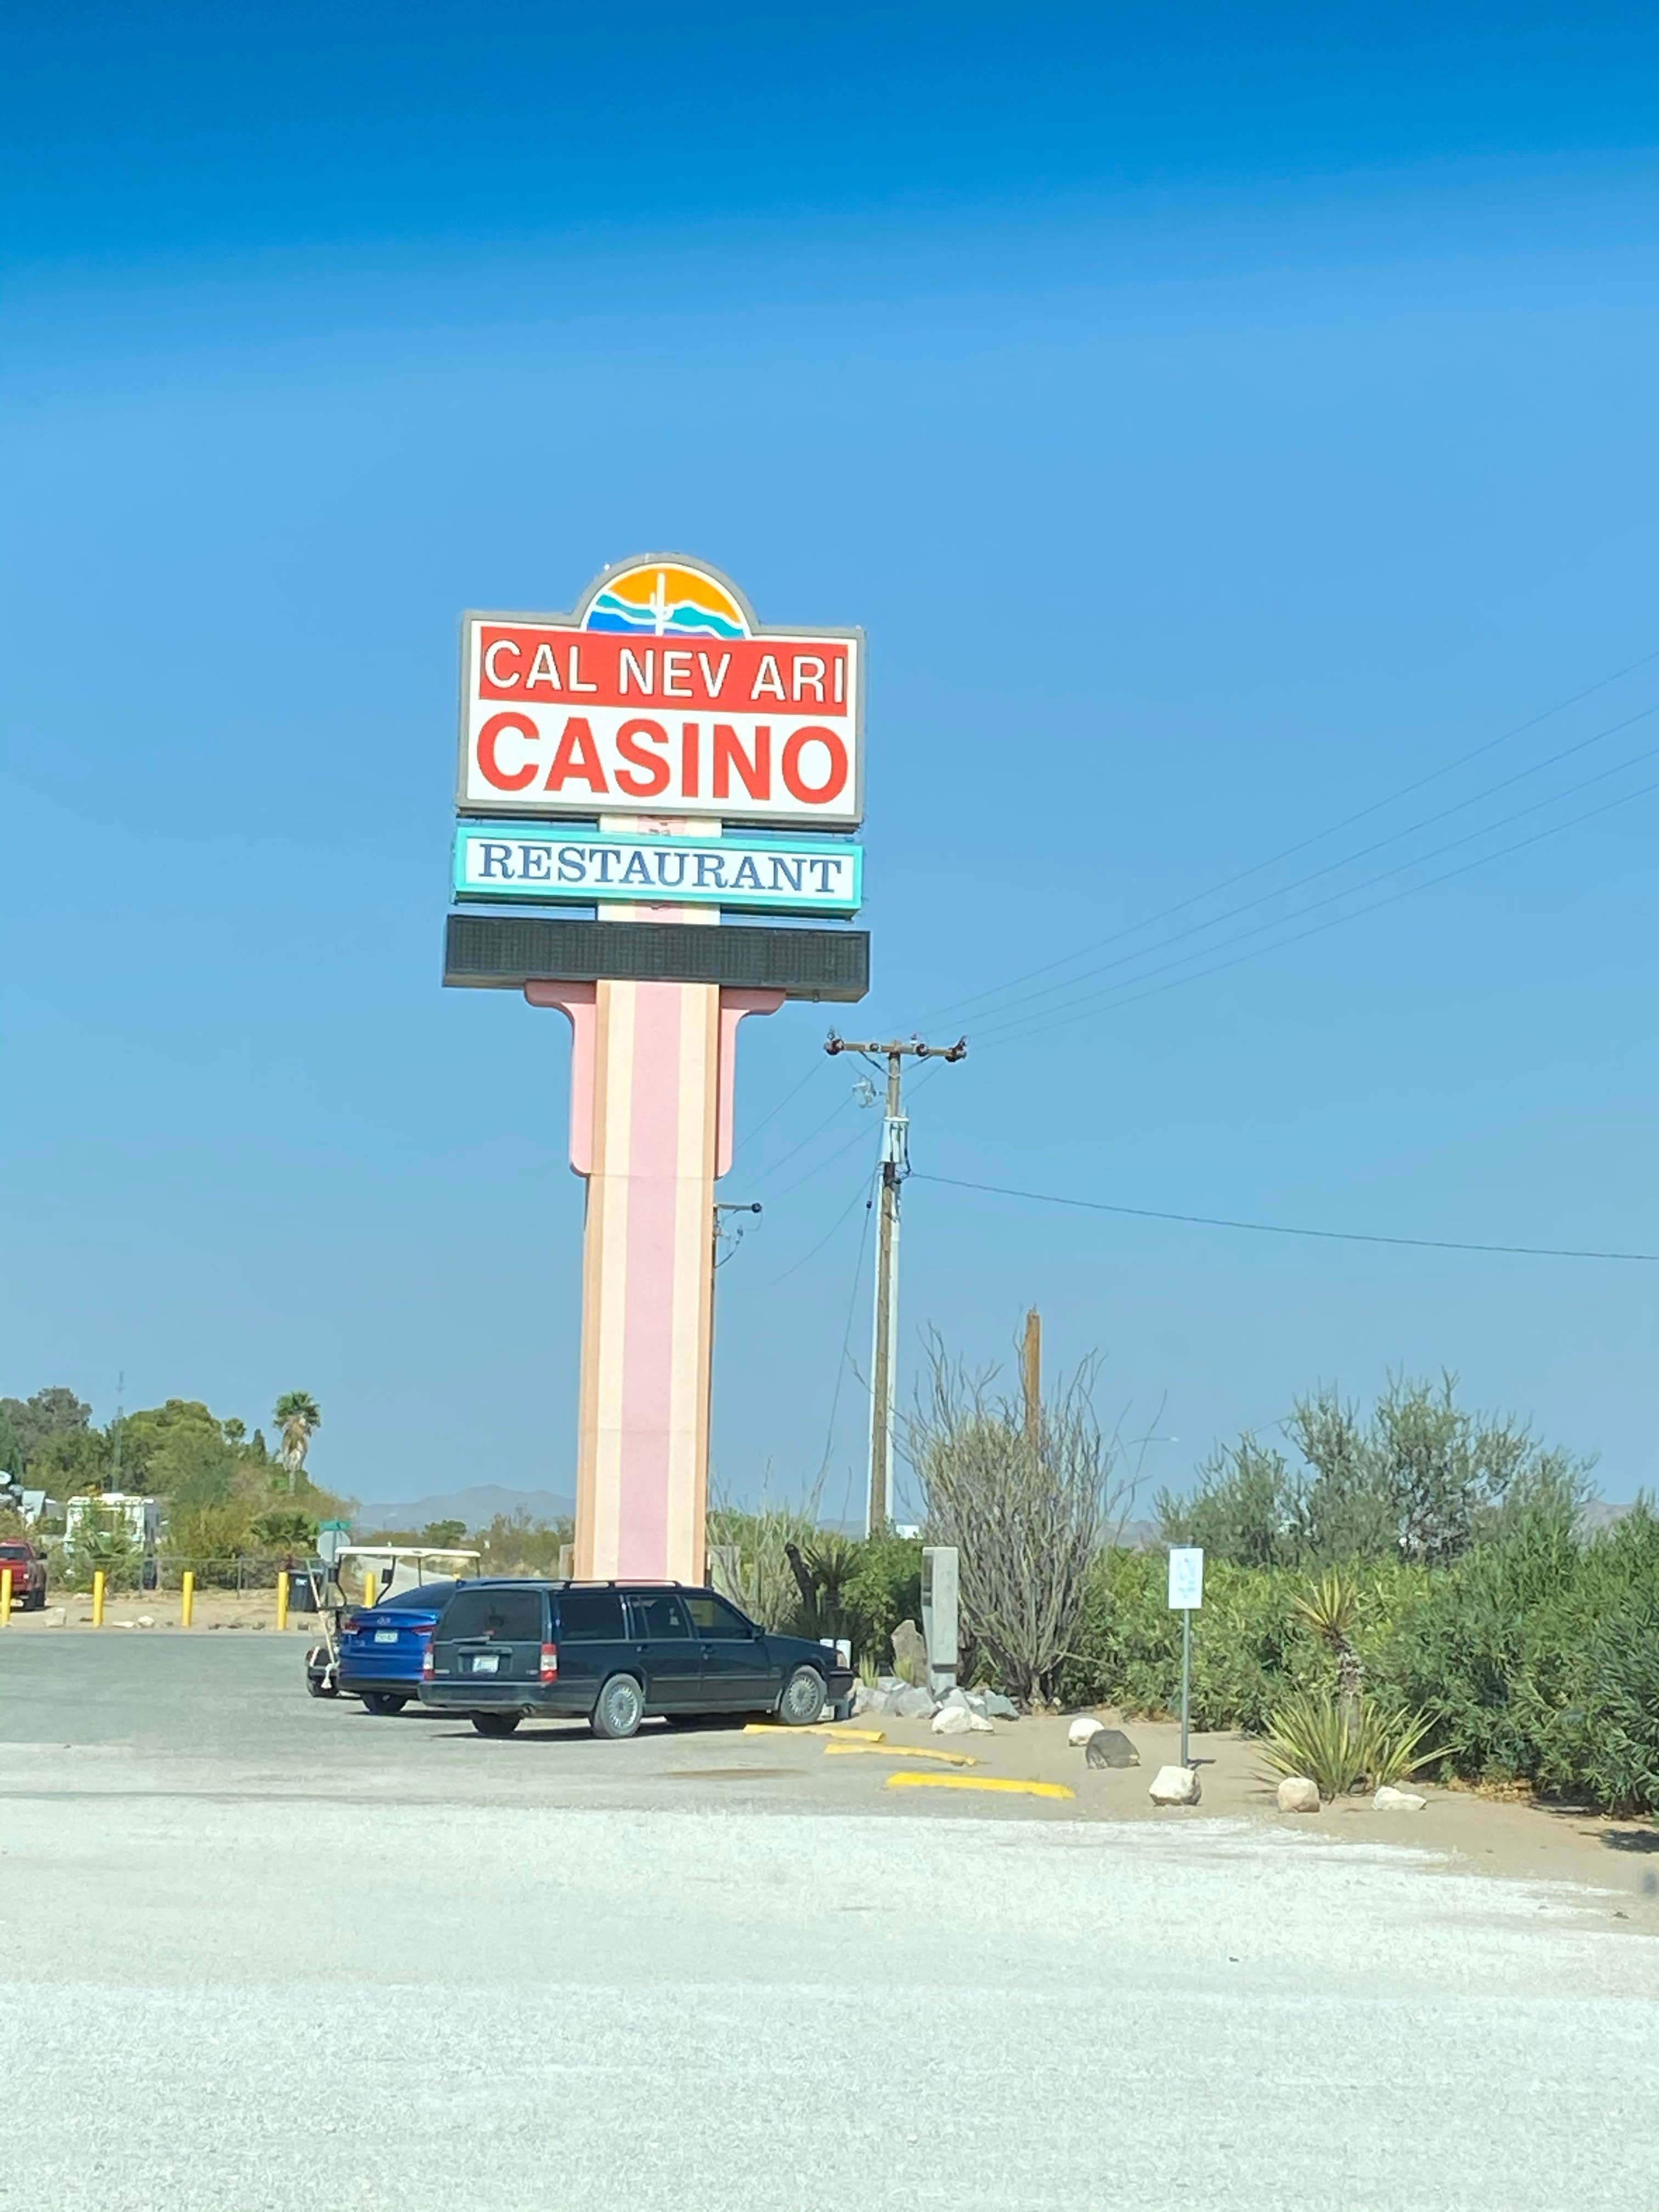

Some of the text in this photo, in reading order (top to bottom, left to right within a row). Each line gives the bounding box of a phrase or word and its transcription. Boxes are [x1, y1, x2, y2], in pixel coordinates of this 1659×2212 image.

[484, 639, 844, 703] CAL NEV ARI
[477, 712, 848, 805] CASINO
[478, 843, 842, 894] RESTAURANT
